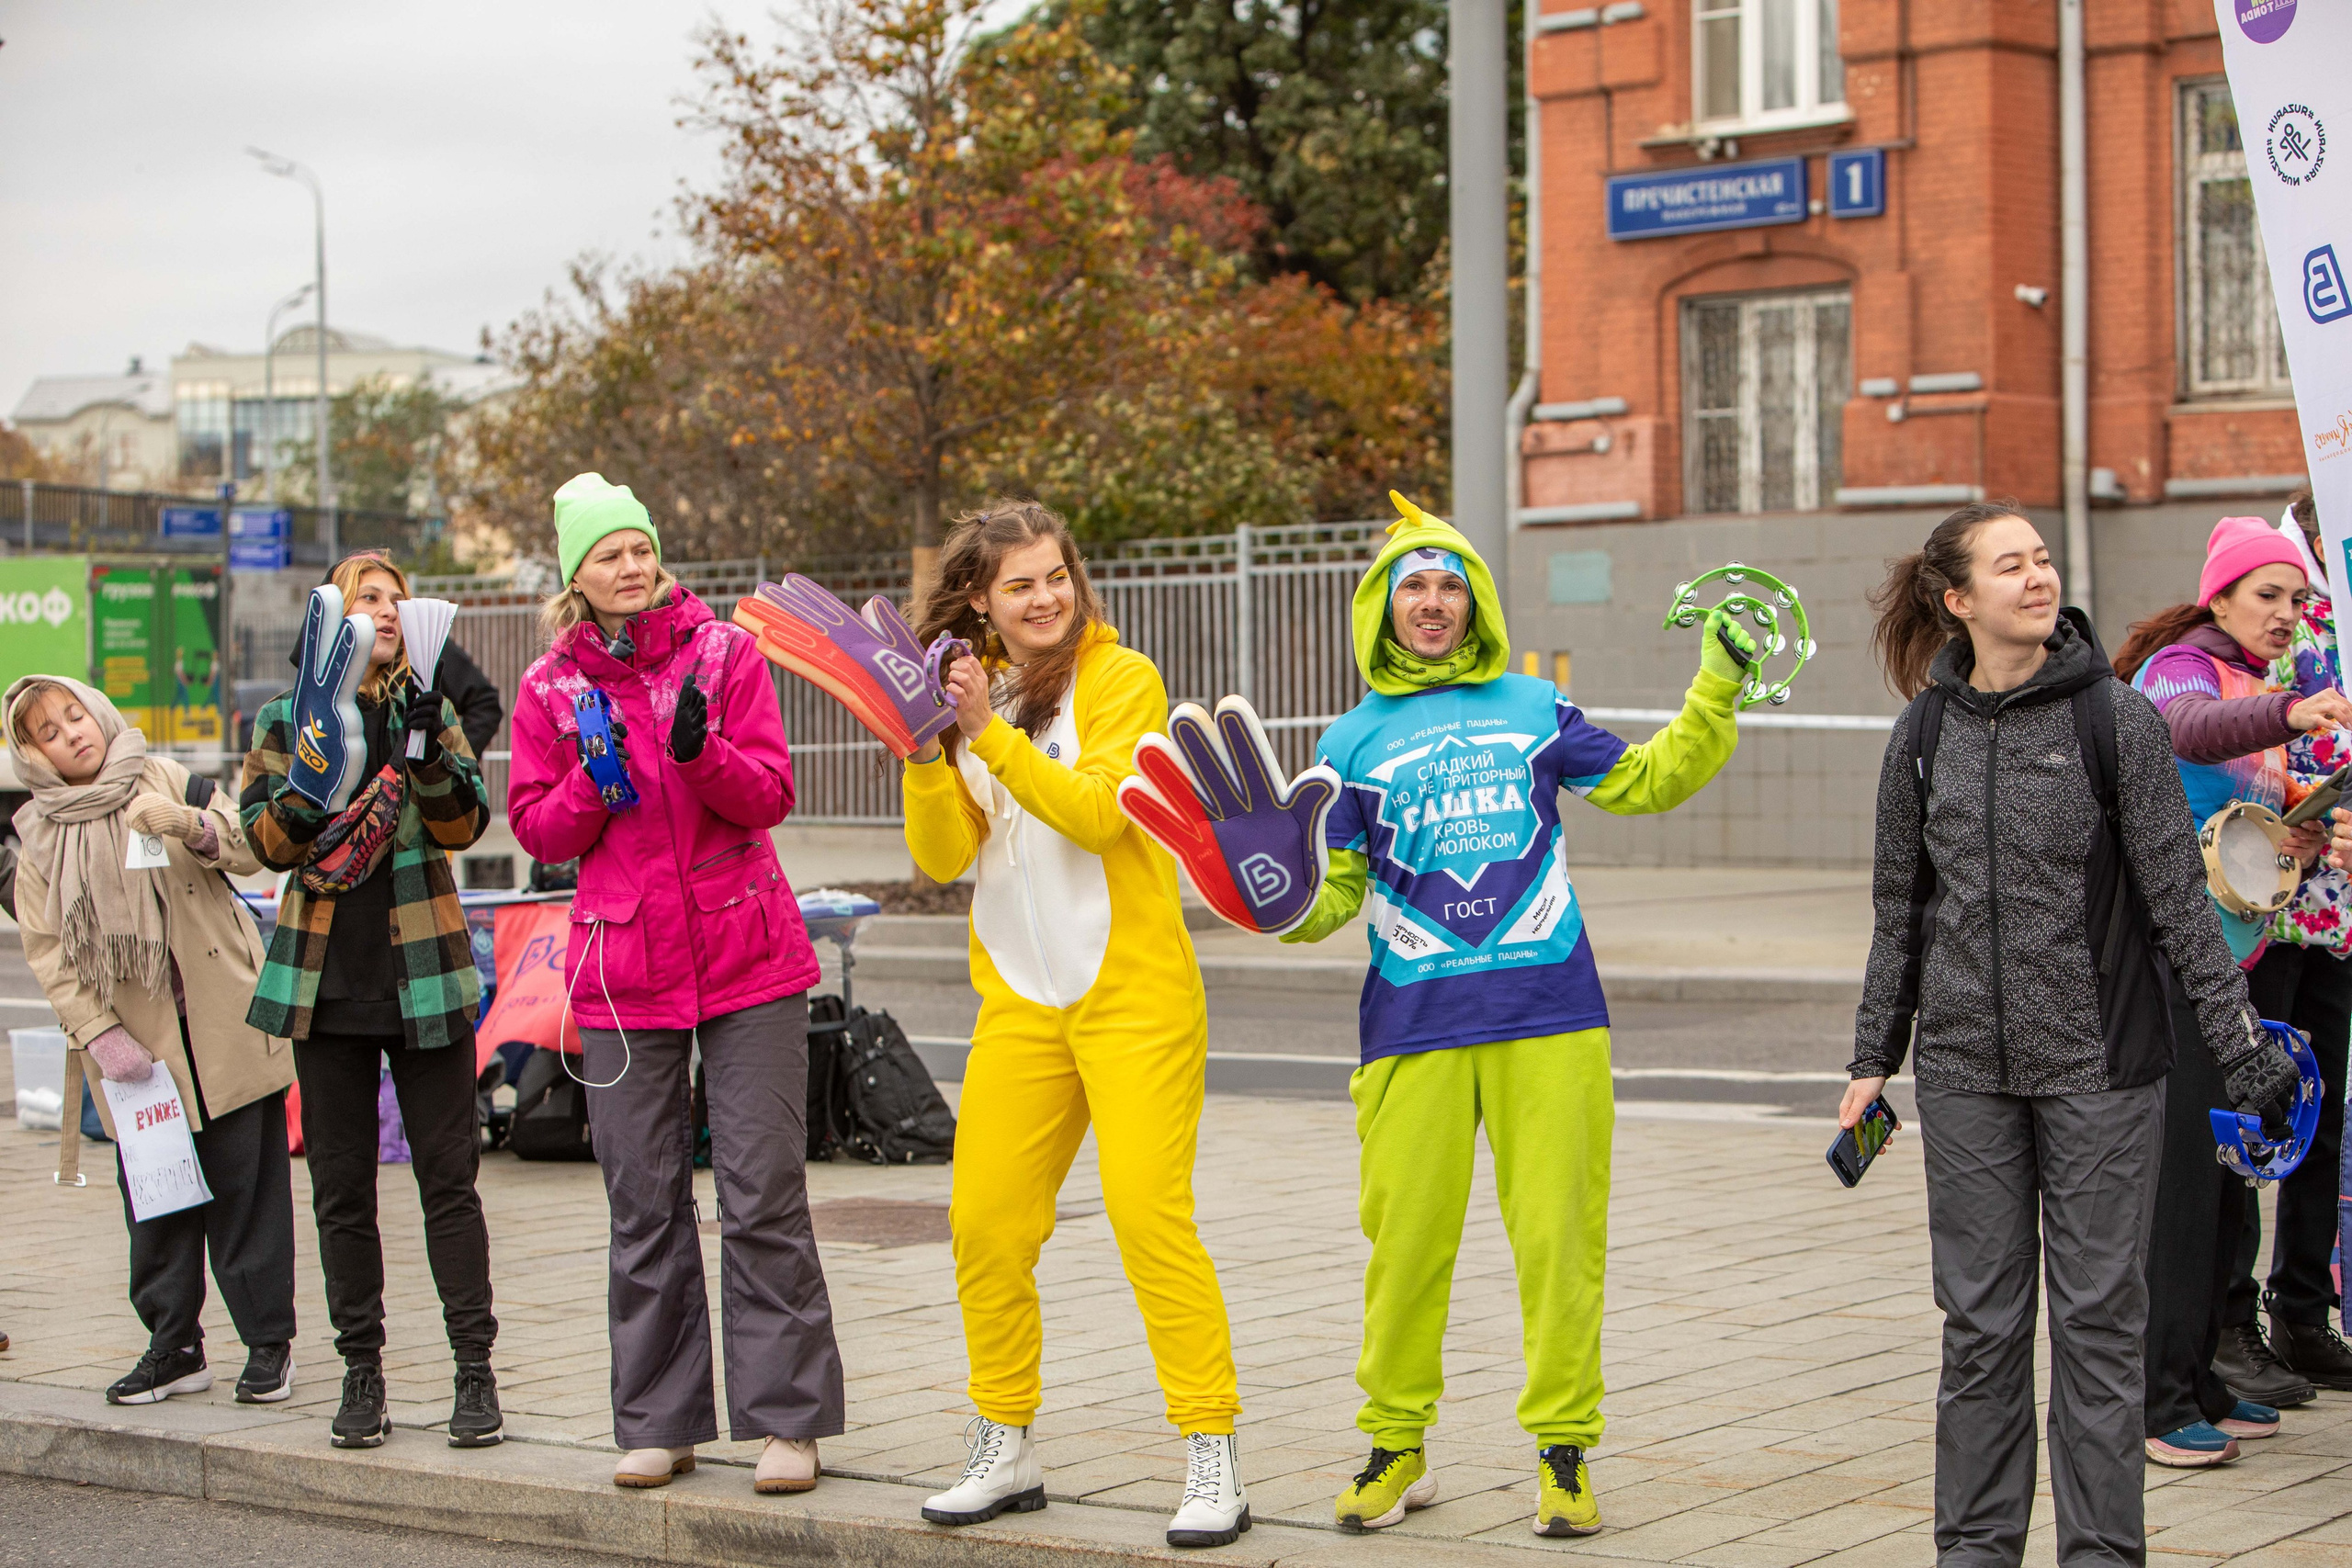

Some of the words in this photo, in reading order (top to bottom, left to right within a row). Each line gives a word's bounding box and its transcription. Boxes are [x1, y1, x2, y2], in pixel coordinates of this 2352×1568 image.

[1623, 172, 1785, 213] ПРЕЧИСТЕНСКАЯ
[1845, 161, 1863, 205] 1
[1386, 738, 1406, 751] ООО
[1409, 721, 1462, 742] «РЕАЛЬНЫЕ
[1466, 718, 1509, 728] ПАЦАНЫ»
[1417, 750, 1495, 782] СЛАДКИЙ
[1391, 791, 1411, 808] НО
[1418, 781, 1436, 797] НЕ
[1443, 764, 1527, 790] ПРИТОРНЫЙ
[1401, 783, 1526, 835] САШКА
[1434, 818, 1490, 840] КРОВЬ
[1434, 831, 1517, 857] МОЛОКОМ
[1443, 897, 1497, 920] ГОСТ
[1395, 922, 1429, 948] ИРНОСТЬ
[1418, 962, 1435, 974] ООО
[1441, 953, 1493, 969] «РЕАЛЬНЫЕ
[1498, 950, 1538, 962] ПАЦАНЫ»
